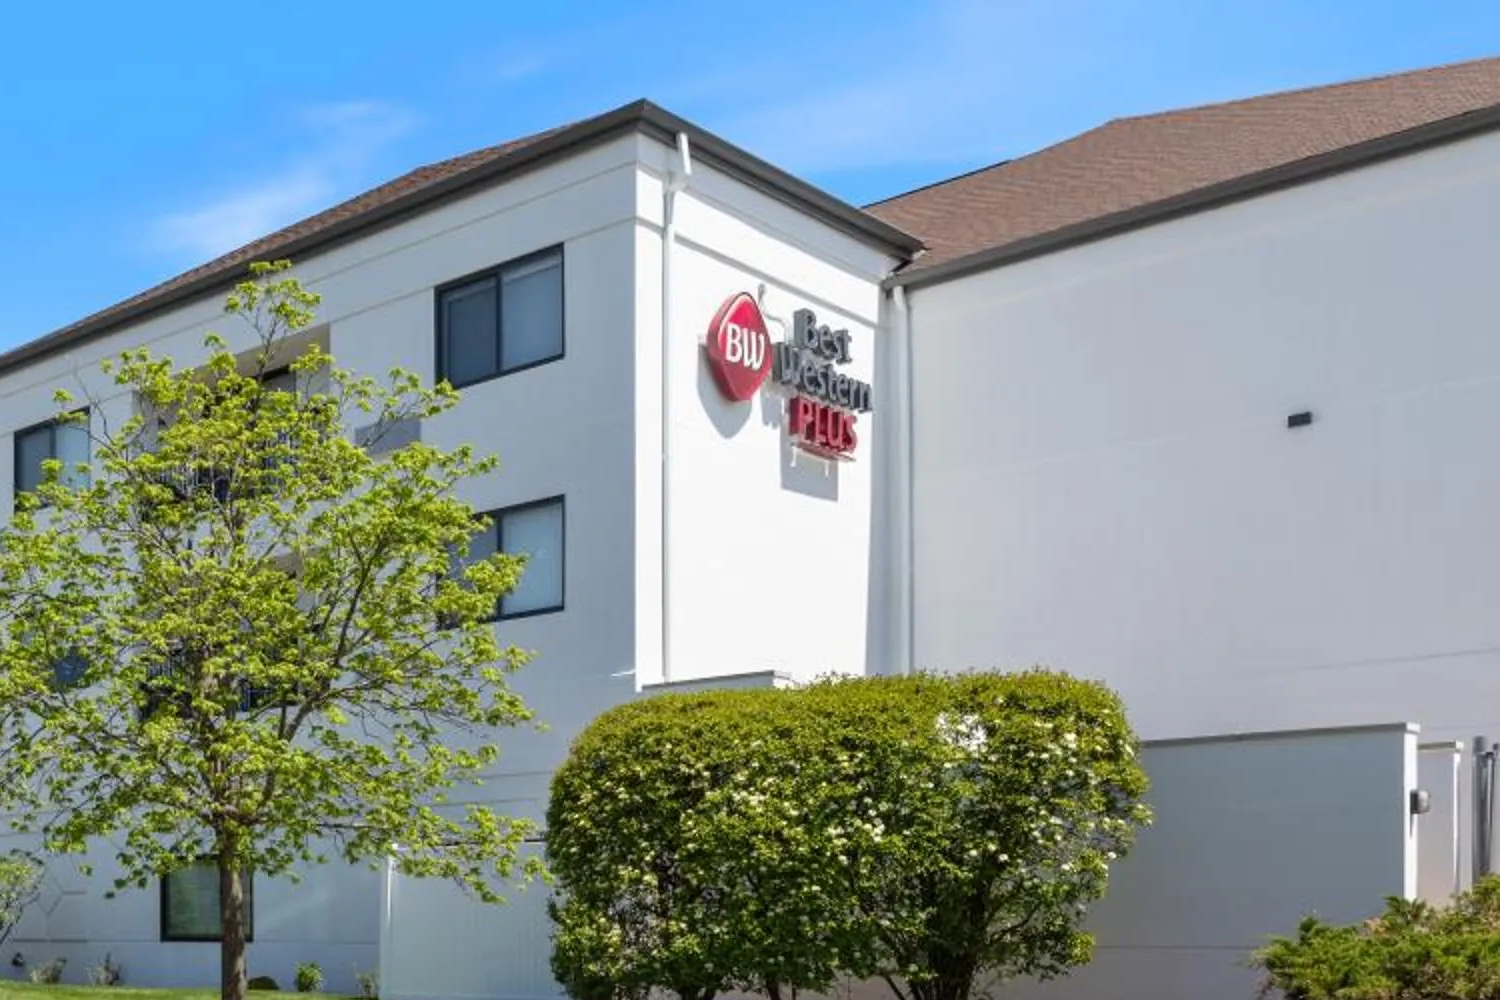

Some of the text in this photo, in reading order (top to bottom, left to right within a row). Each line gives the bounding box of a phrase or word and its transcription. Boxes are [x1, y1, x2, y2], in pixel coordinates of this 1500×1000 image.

[725, 323, 766, 371] BW
[794, 308, 852, 365] Best
[776, 341, 873, 413] Western
[792, 394, 857, 454] PLUS
